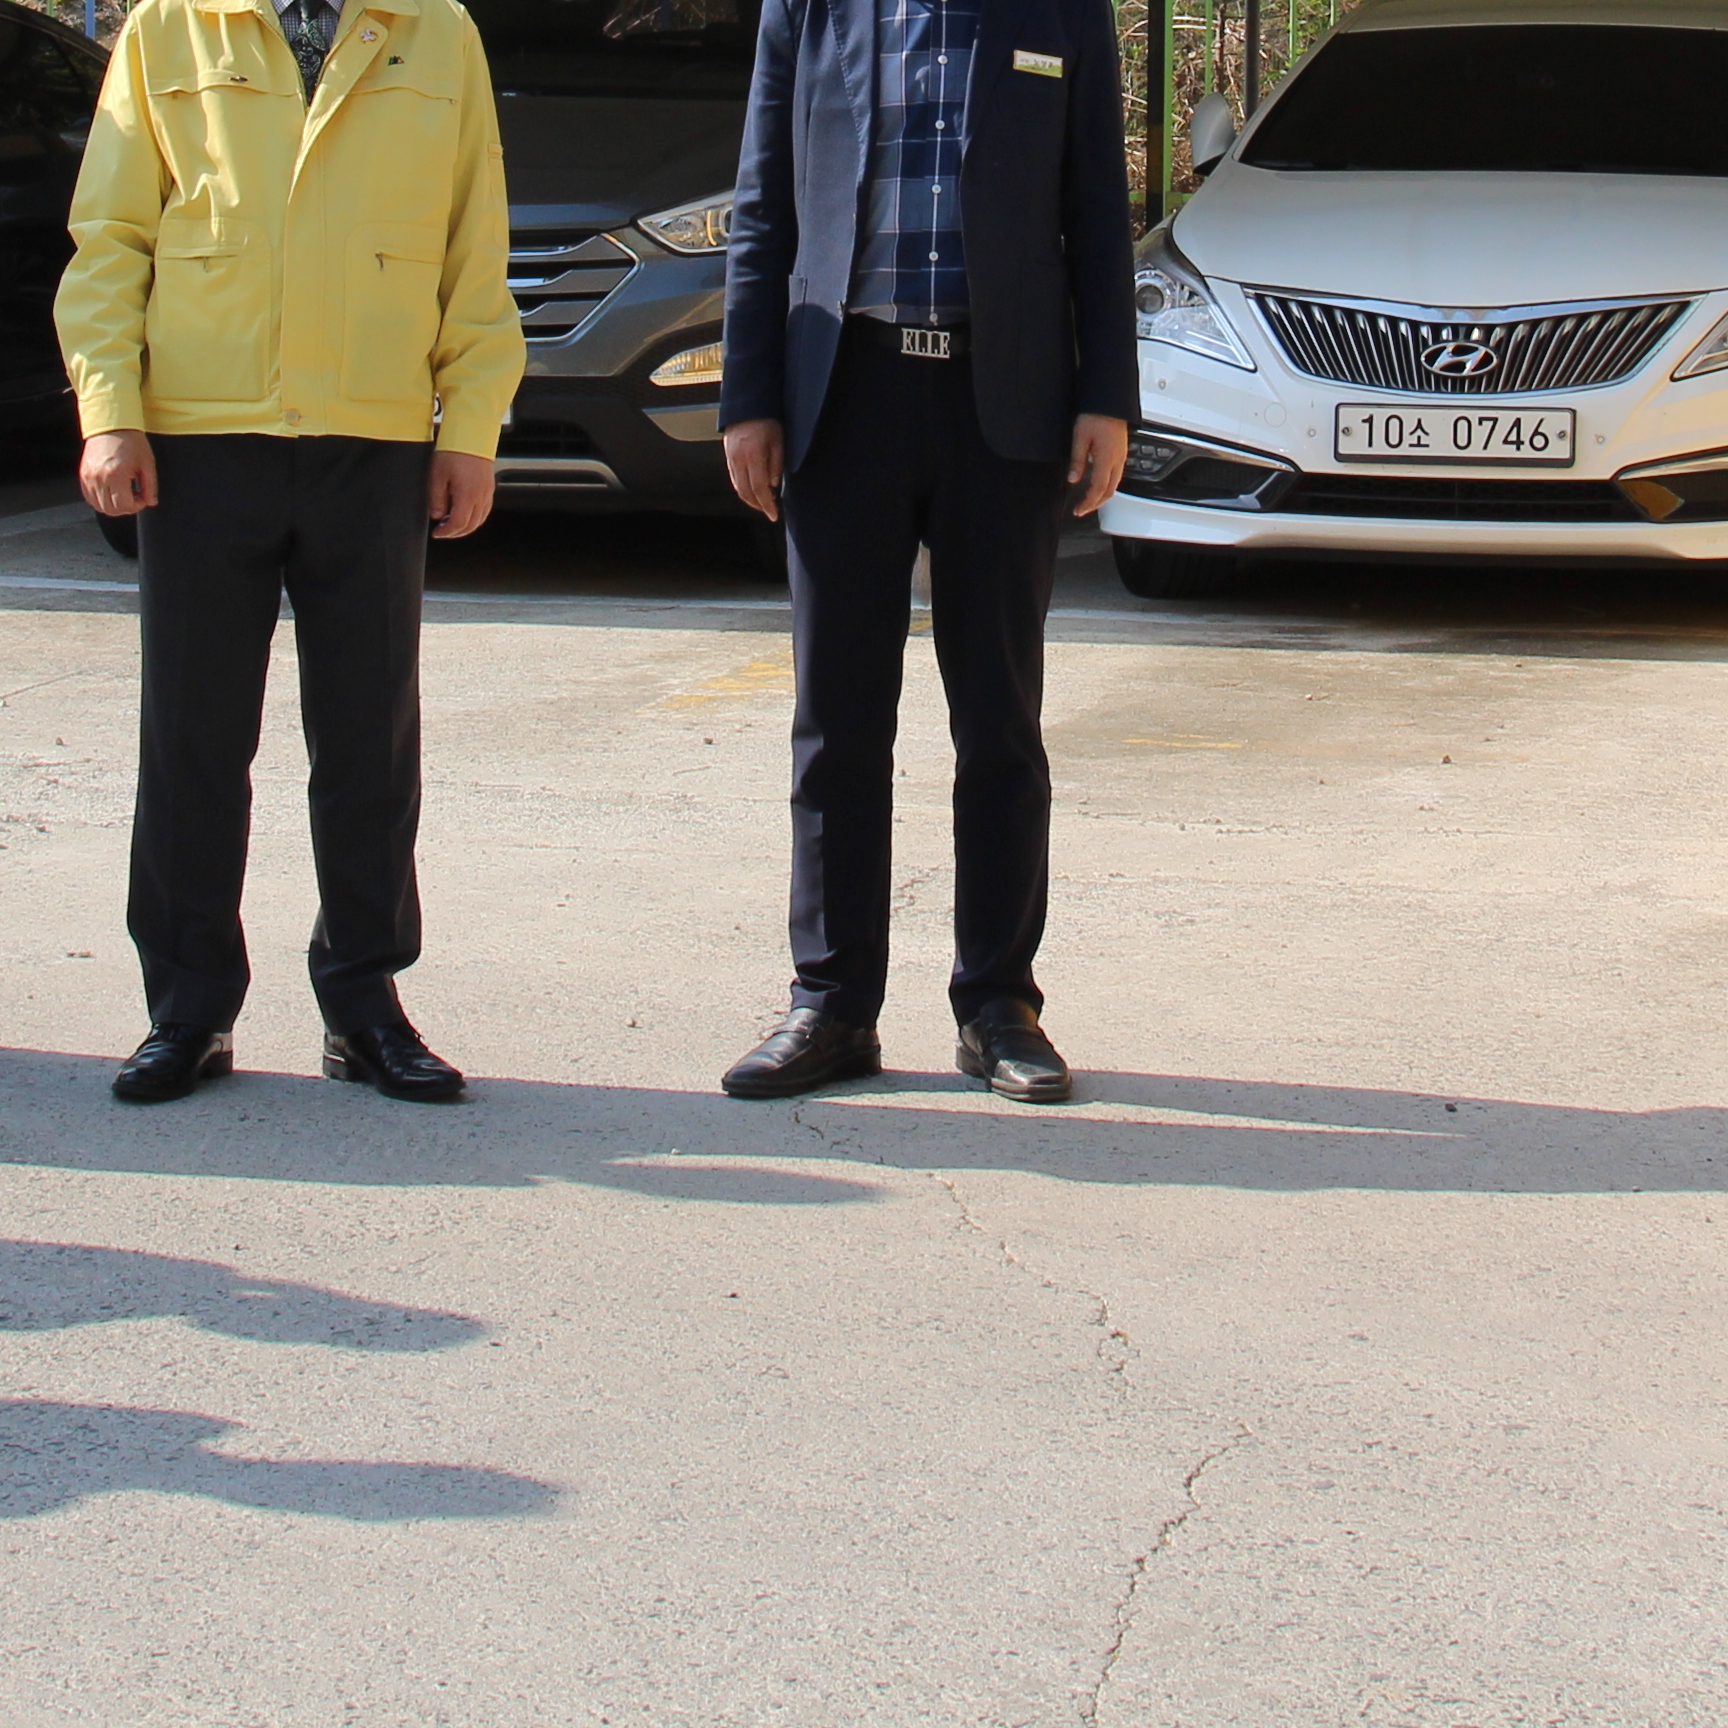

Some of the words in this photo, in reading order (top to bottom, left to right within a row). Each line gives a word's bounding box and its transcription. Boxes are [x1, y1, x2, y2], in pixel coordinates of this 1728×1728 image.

[901, 328, 950, 359] ELLE
[1360, 413, 1431, 450] 10소
[1451, 415, 1550, 452] 0746
